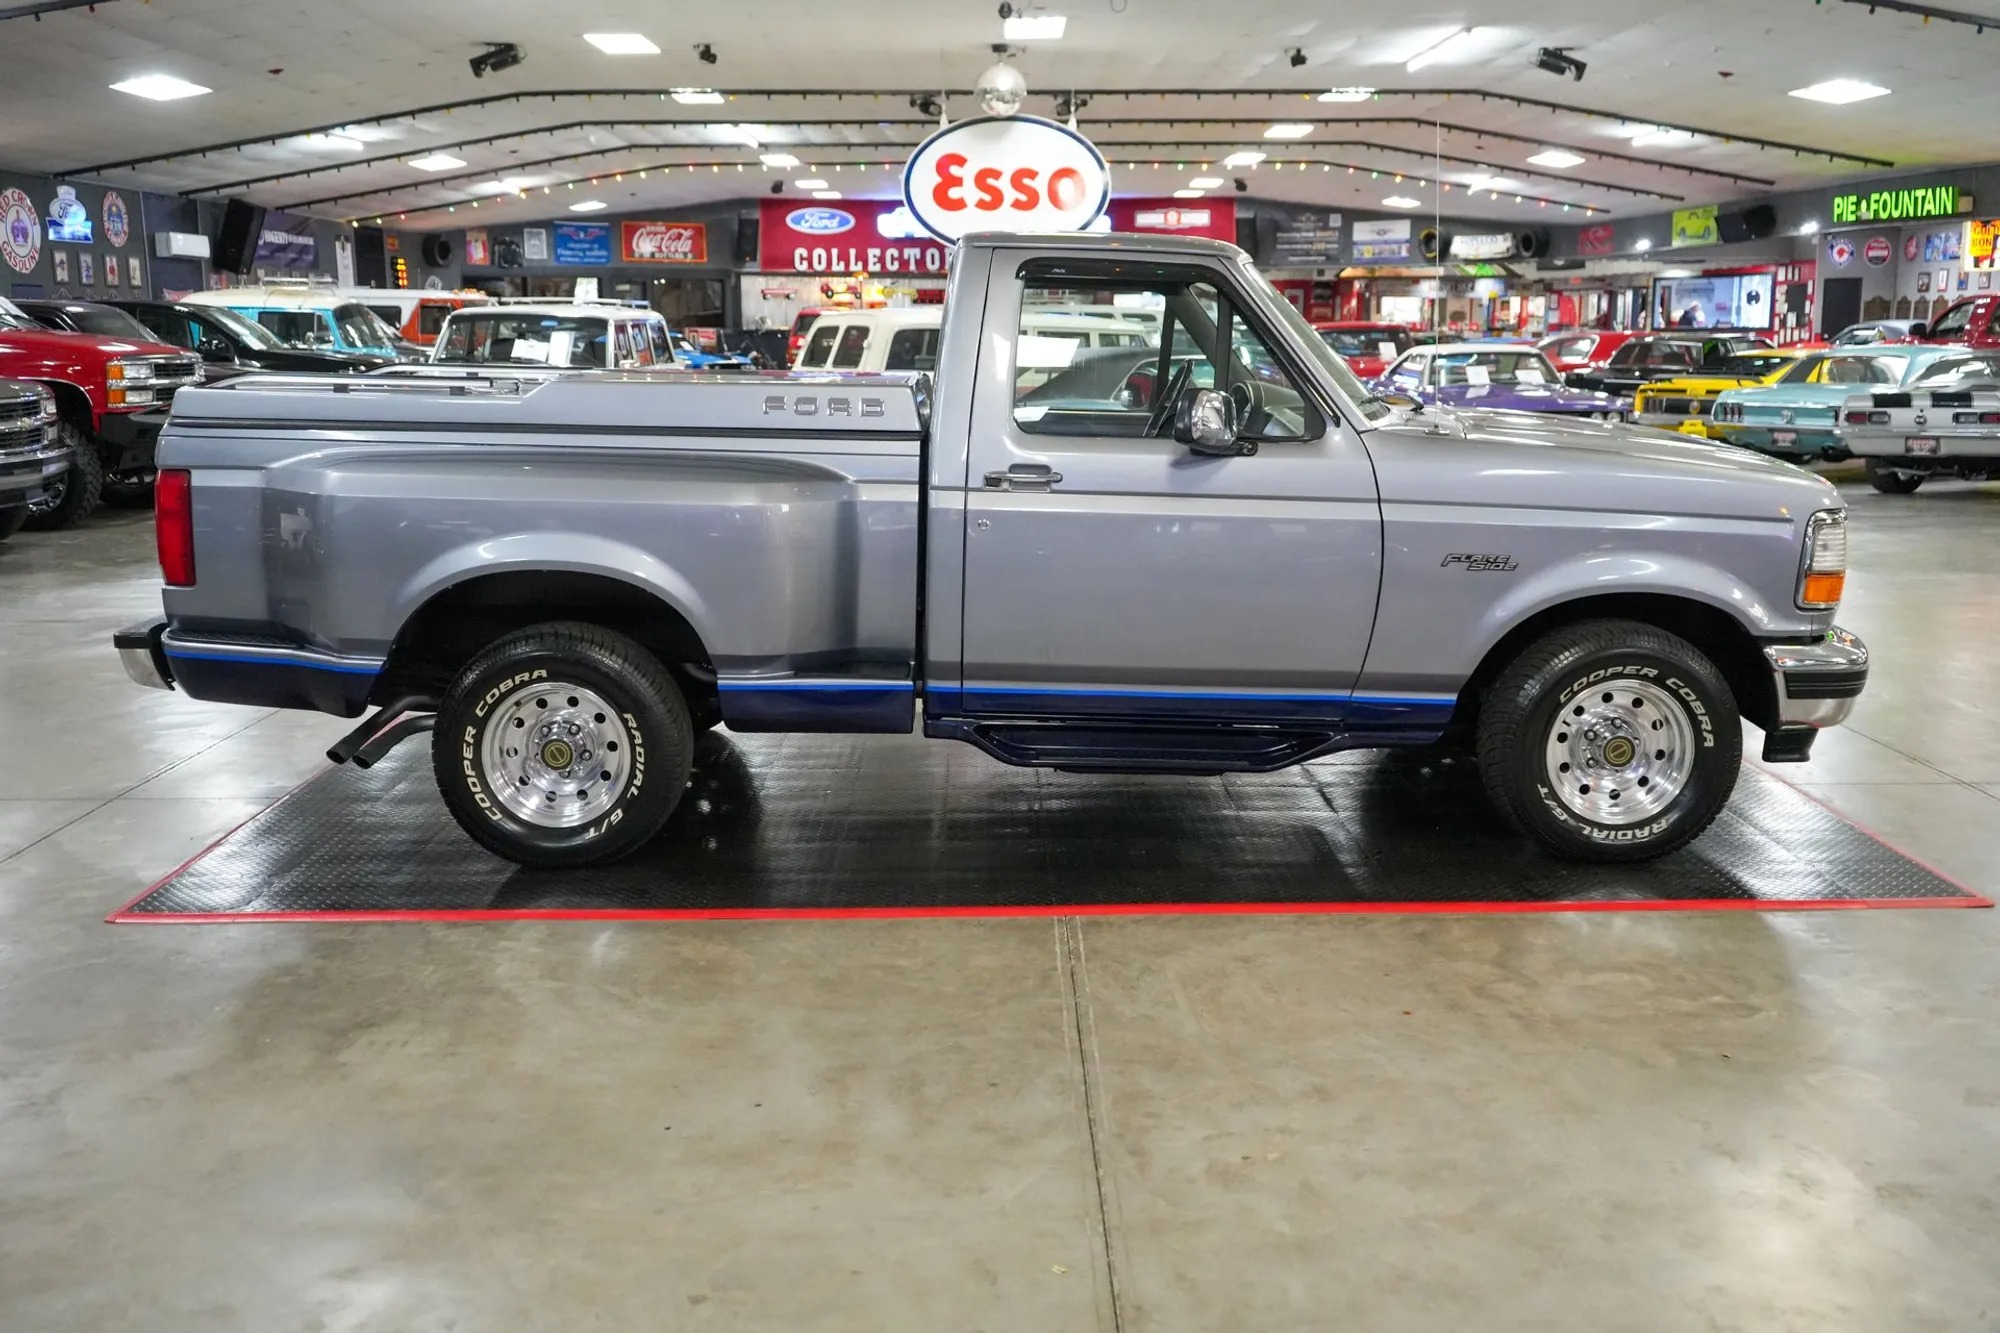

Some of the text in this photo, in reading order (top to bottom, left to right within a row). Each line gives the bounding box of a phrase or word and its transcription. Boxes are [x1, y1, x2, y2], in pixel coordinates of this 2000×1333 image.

[1834, 186, 1953, 222] PIE FOUNTAIN
[801, 211, 839, 229] Ford
[1972, 237, 1993, 247] BON
[763, 396, 885, 417] FORD
[1559, 665, 1714, 747] COOPER COBRA
[463, 669, 548, 821] COOPER COBRA
[622, 713, 645, 799] RADIAL
[1577, 818, 1668, 840] RADIAL
